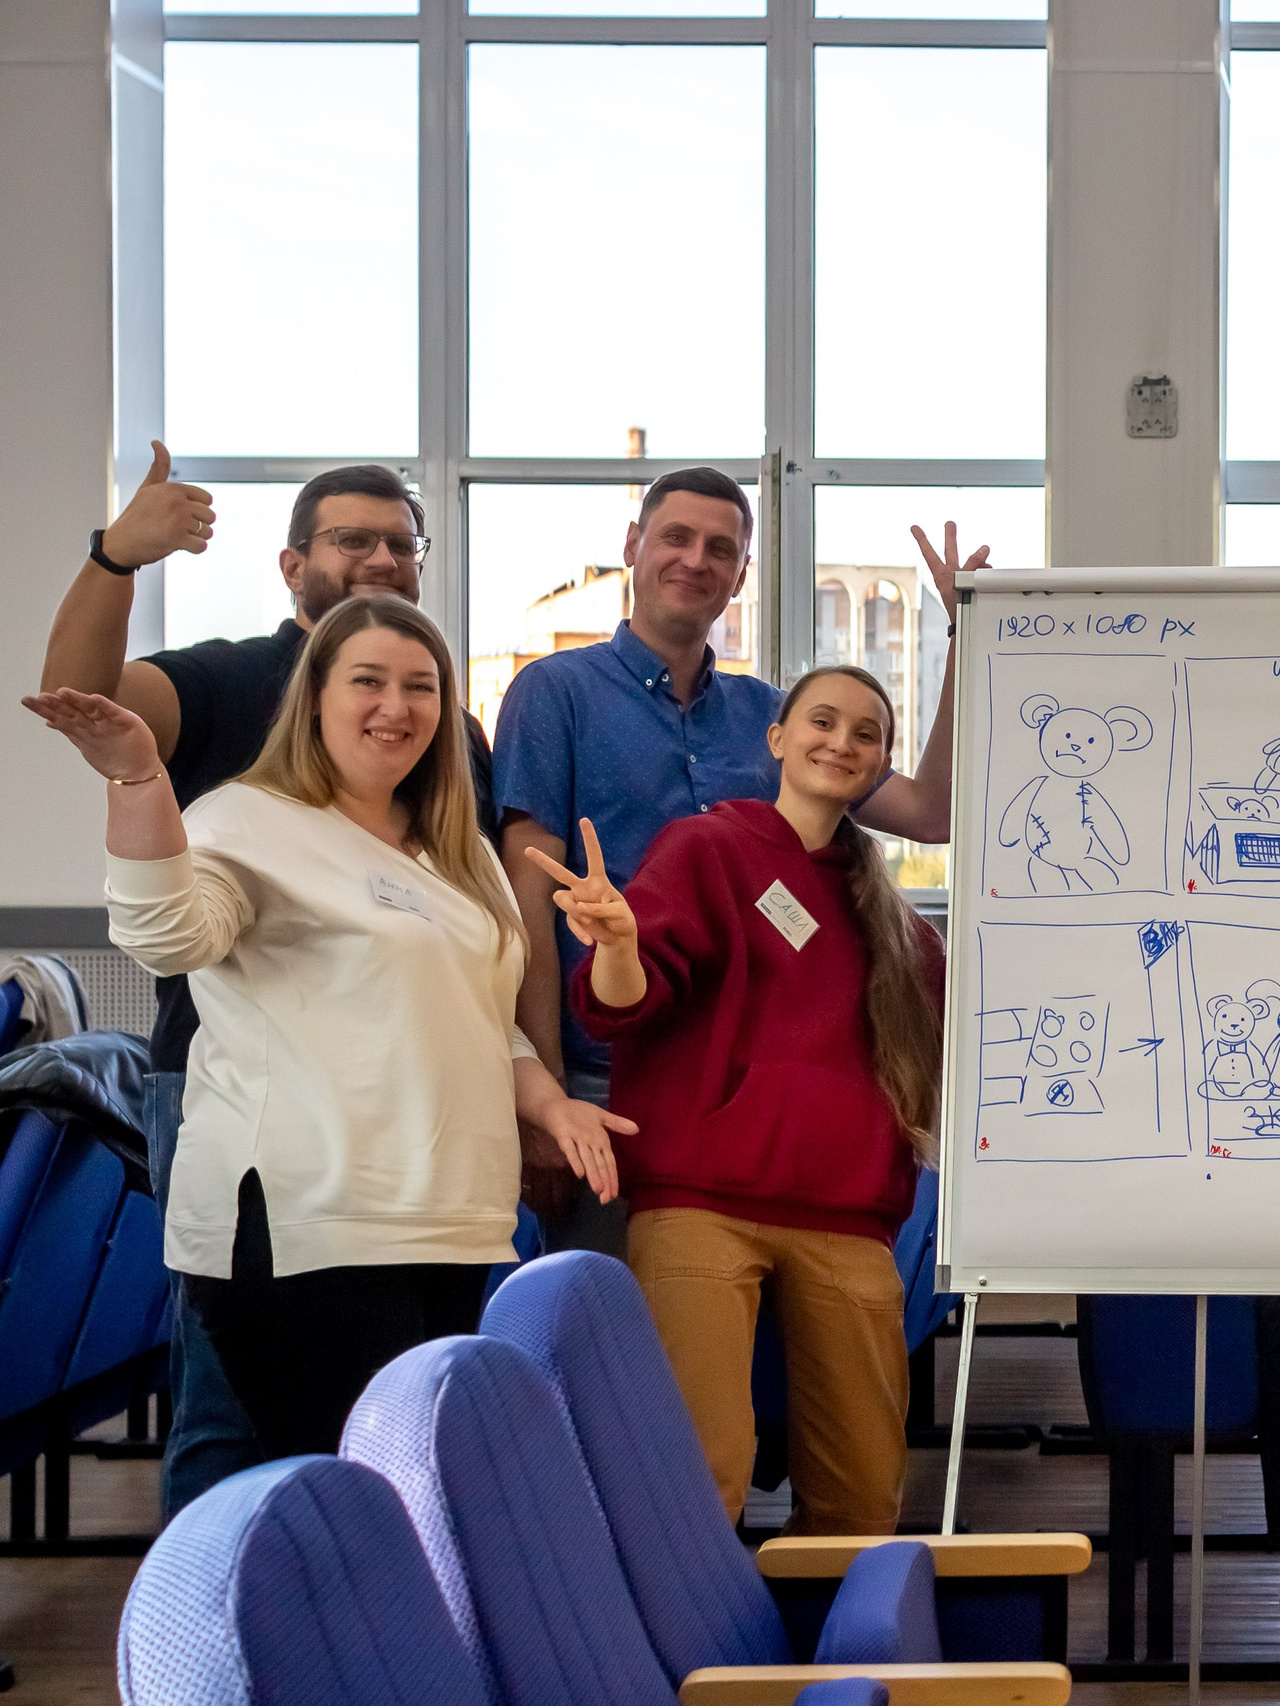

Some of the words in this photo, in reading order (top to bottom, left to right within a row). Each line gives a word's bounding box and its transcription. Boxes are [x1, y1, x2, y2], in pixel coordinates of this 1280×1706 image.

[998, 614, 1056, 641] 1920
[1160, 617, 1196, 643] px
[768, 892, 809, 933] САША
